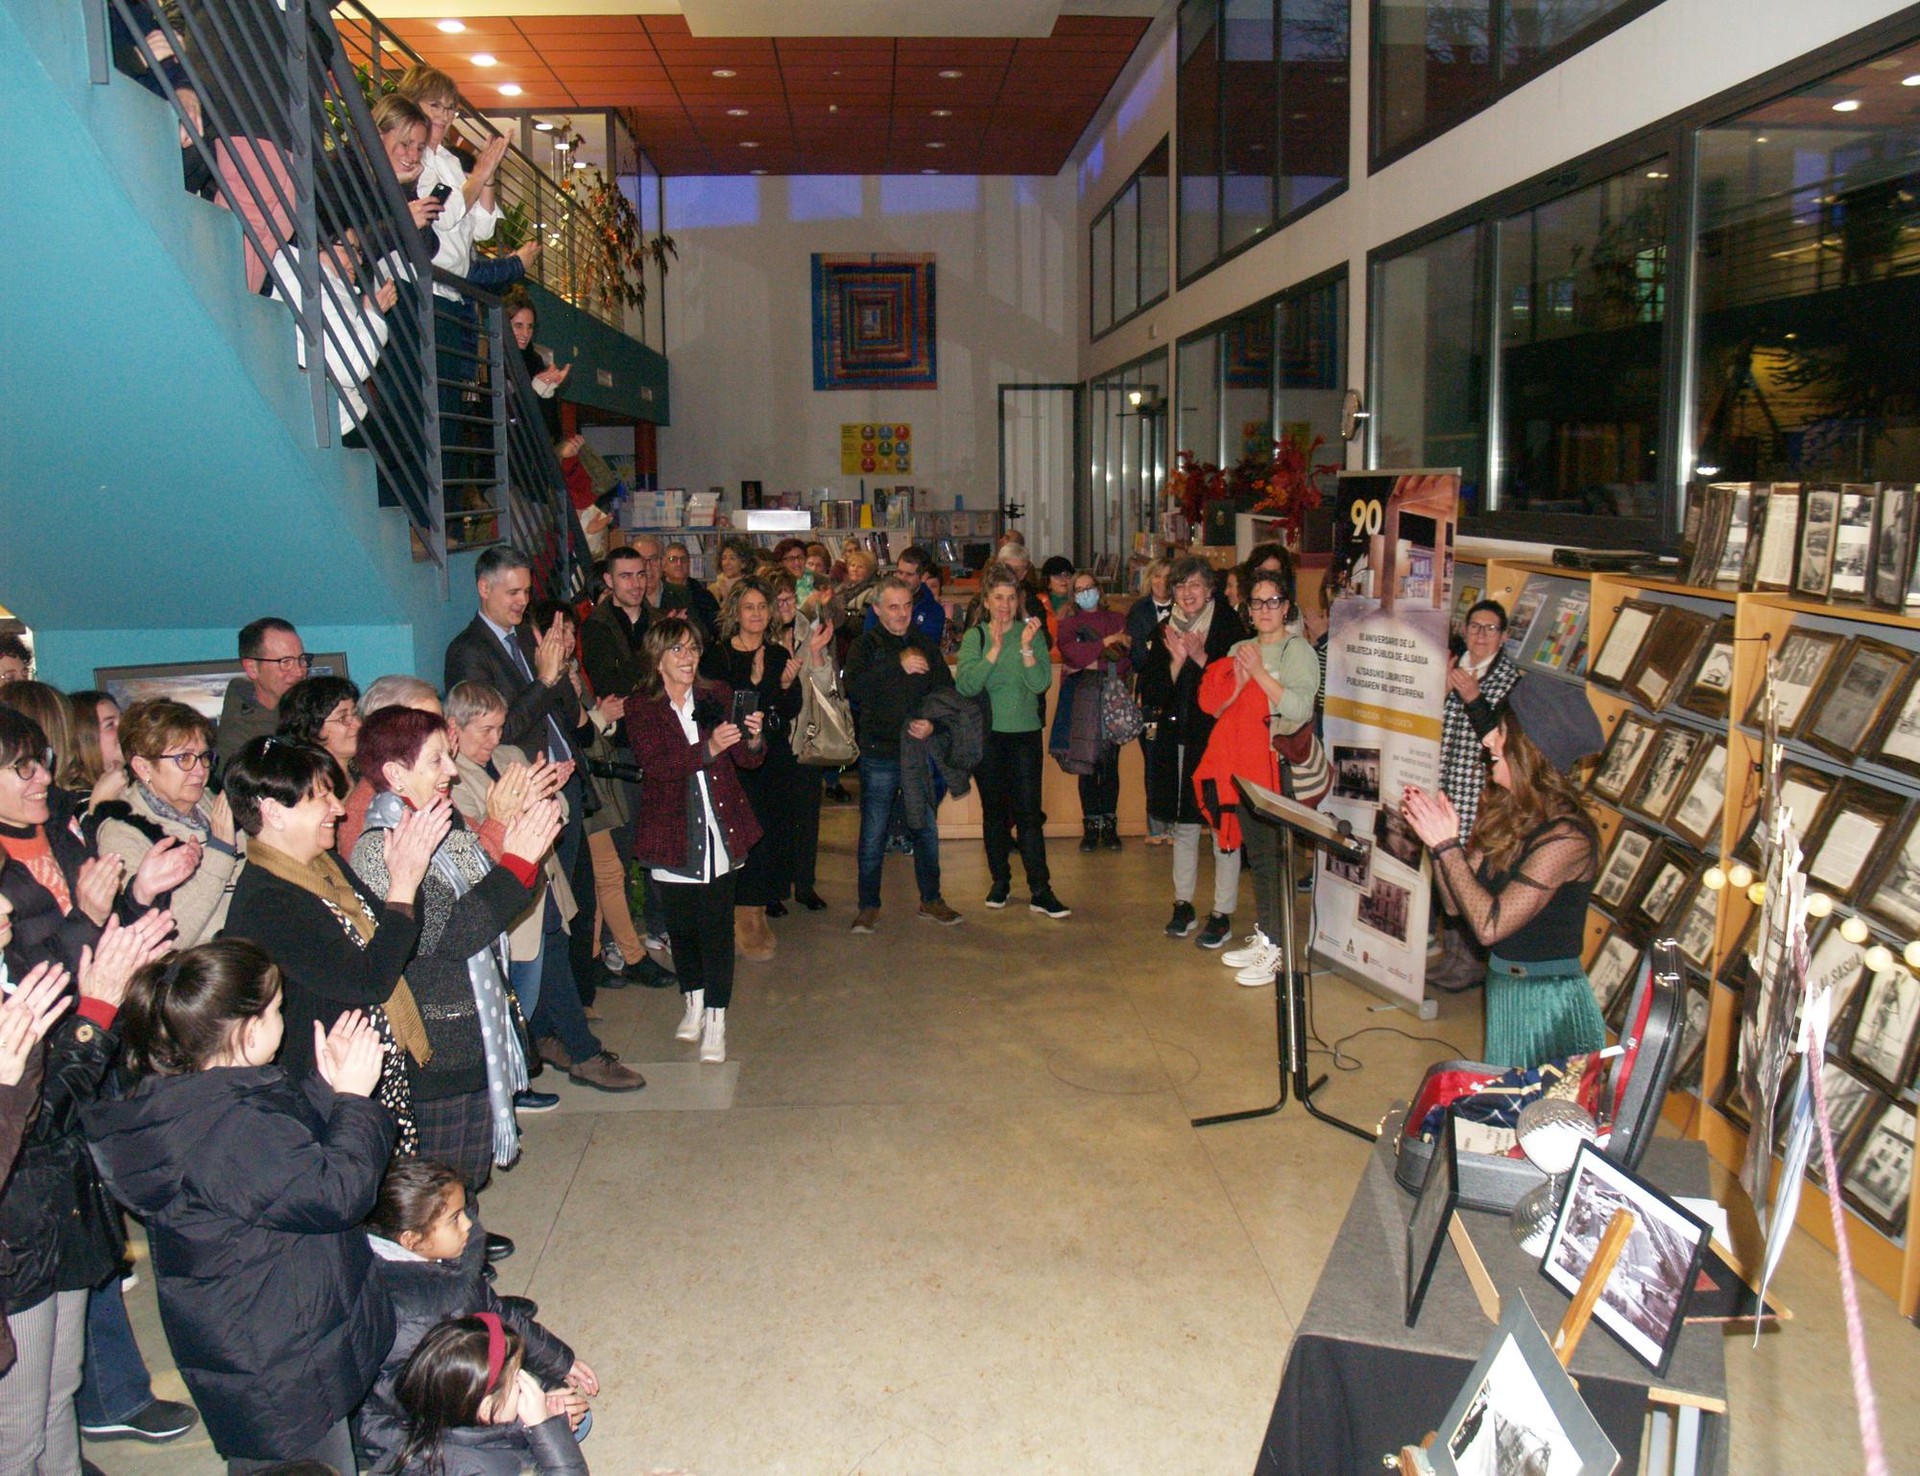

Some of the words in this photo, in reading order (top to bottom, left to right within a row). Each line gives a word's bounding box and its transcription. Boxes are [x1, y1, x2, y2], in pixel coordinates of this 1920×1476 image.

[1351, 499, 1382, 536] 90
[1346, 643, 1372, 656] BIBLIOTECA
[1395, 652, 1403, 661] DE
[1403, 653, 1429, 665] ALSASUA
[1399, 638, 1408, 648] DE
[1408, 640, 1416, 649] LA
